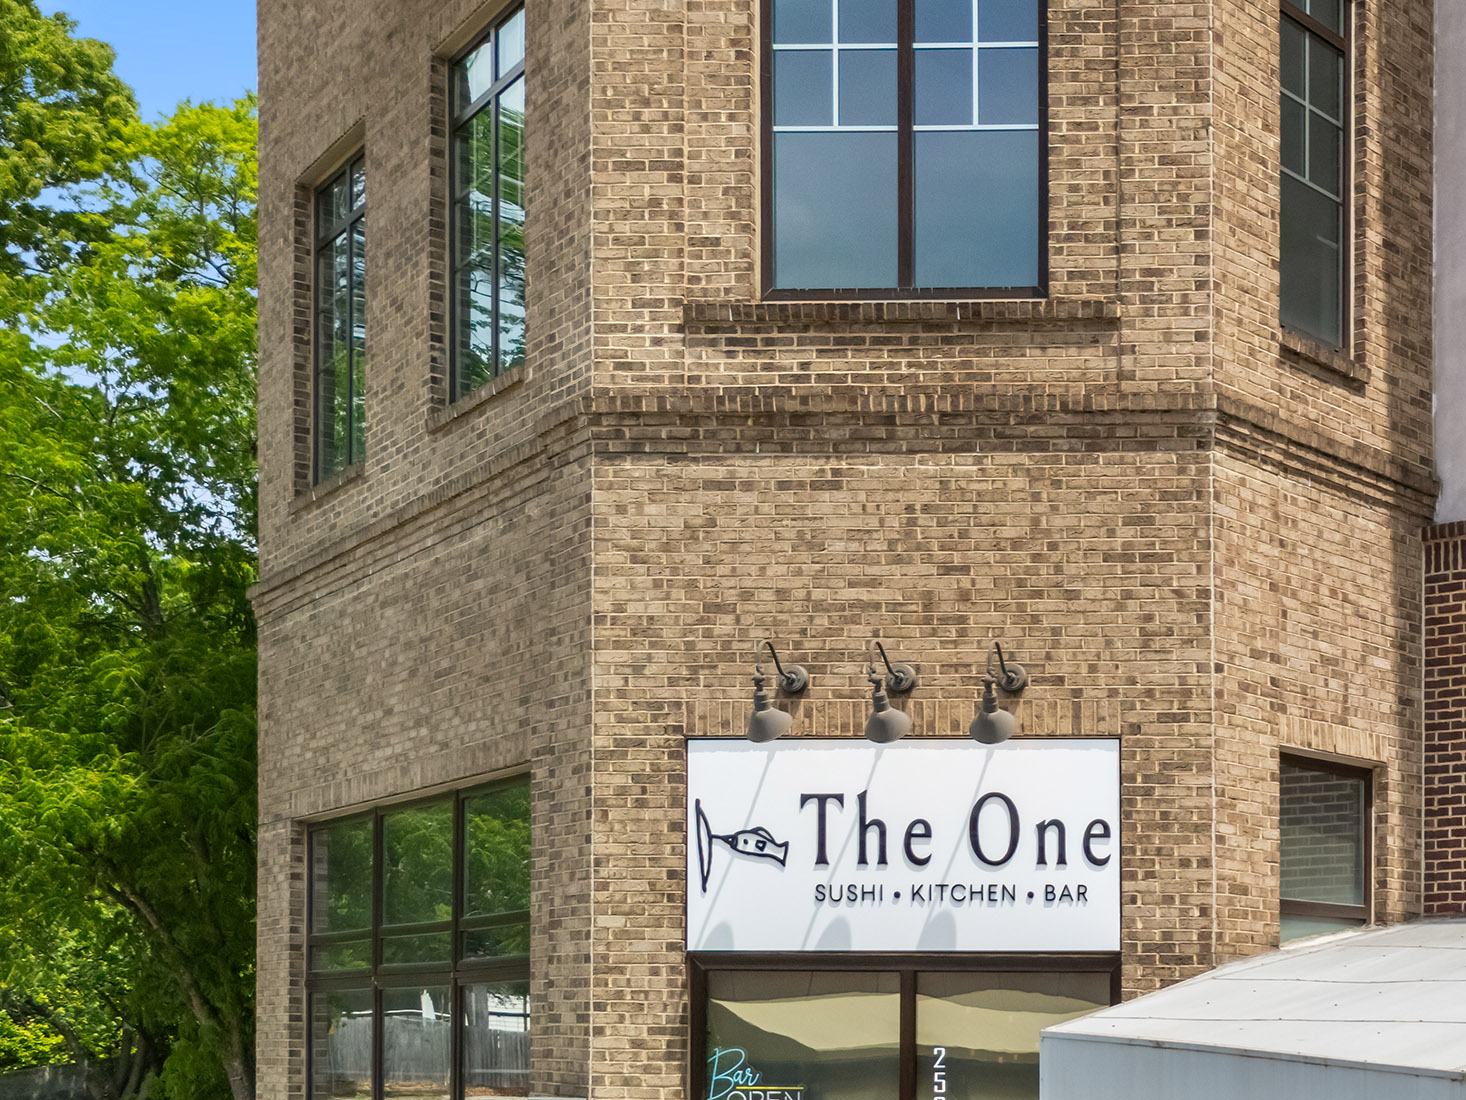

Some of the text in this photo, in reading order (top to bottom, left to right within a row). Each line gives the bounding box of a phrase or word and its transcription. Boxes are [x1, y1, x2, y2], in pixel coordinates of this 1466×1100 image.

[800, 790, 1112, 867] The One
[814, 883, 1089, 903] SUSHI KITCHEN BAR
